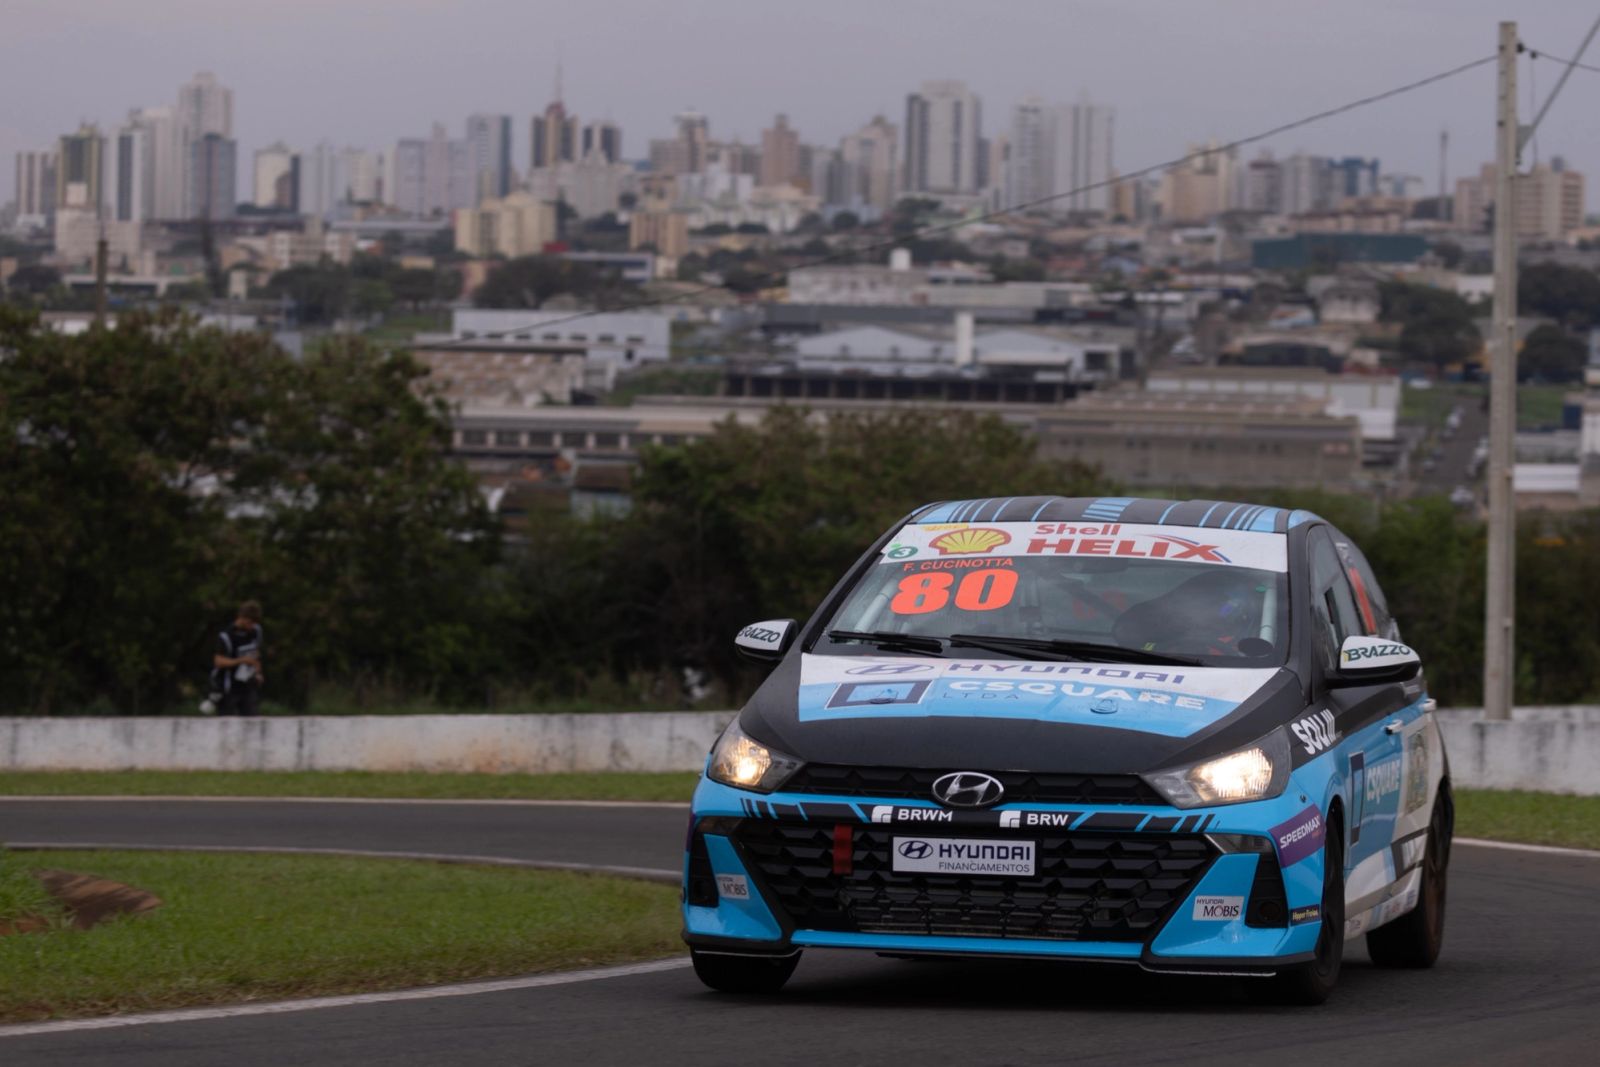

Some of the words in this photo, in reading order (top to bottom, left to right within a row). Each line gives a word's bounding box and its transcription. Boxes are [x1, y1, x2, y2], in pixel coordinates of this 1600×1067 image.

[1035, 523, 1121, 536] Shell
[1026, 536, 1224, 563] HELIX
[903, 563, 915, 572] F.
[920, 558, 1013, 571] CUCINOTTA
[890, 568, 1019, 615] 80
[1344, 644, 1411, 662] BRAZZO
[948, 663, 1185, 684] HYUNDAI
[943, 692, 1020, 700] LTDA
[949, 680, 1207, 710] CSQUARE
[897, 808, 954, 822] BRWM
[1026, 813, 1069, 827] BRW
[1280, 815, 1321, 849] SPEEDMAX
[938, 843, 1031, 861] HYUNDAI
[938, 861, 1030, 873] FINANCIAMENTOS
[1202, 905, 1240, 918] MOBIS
